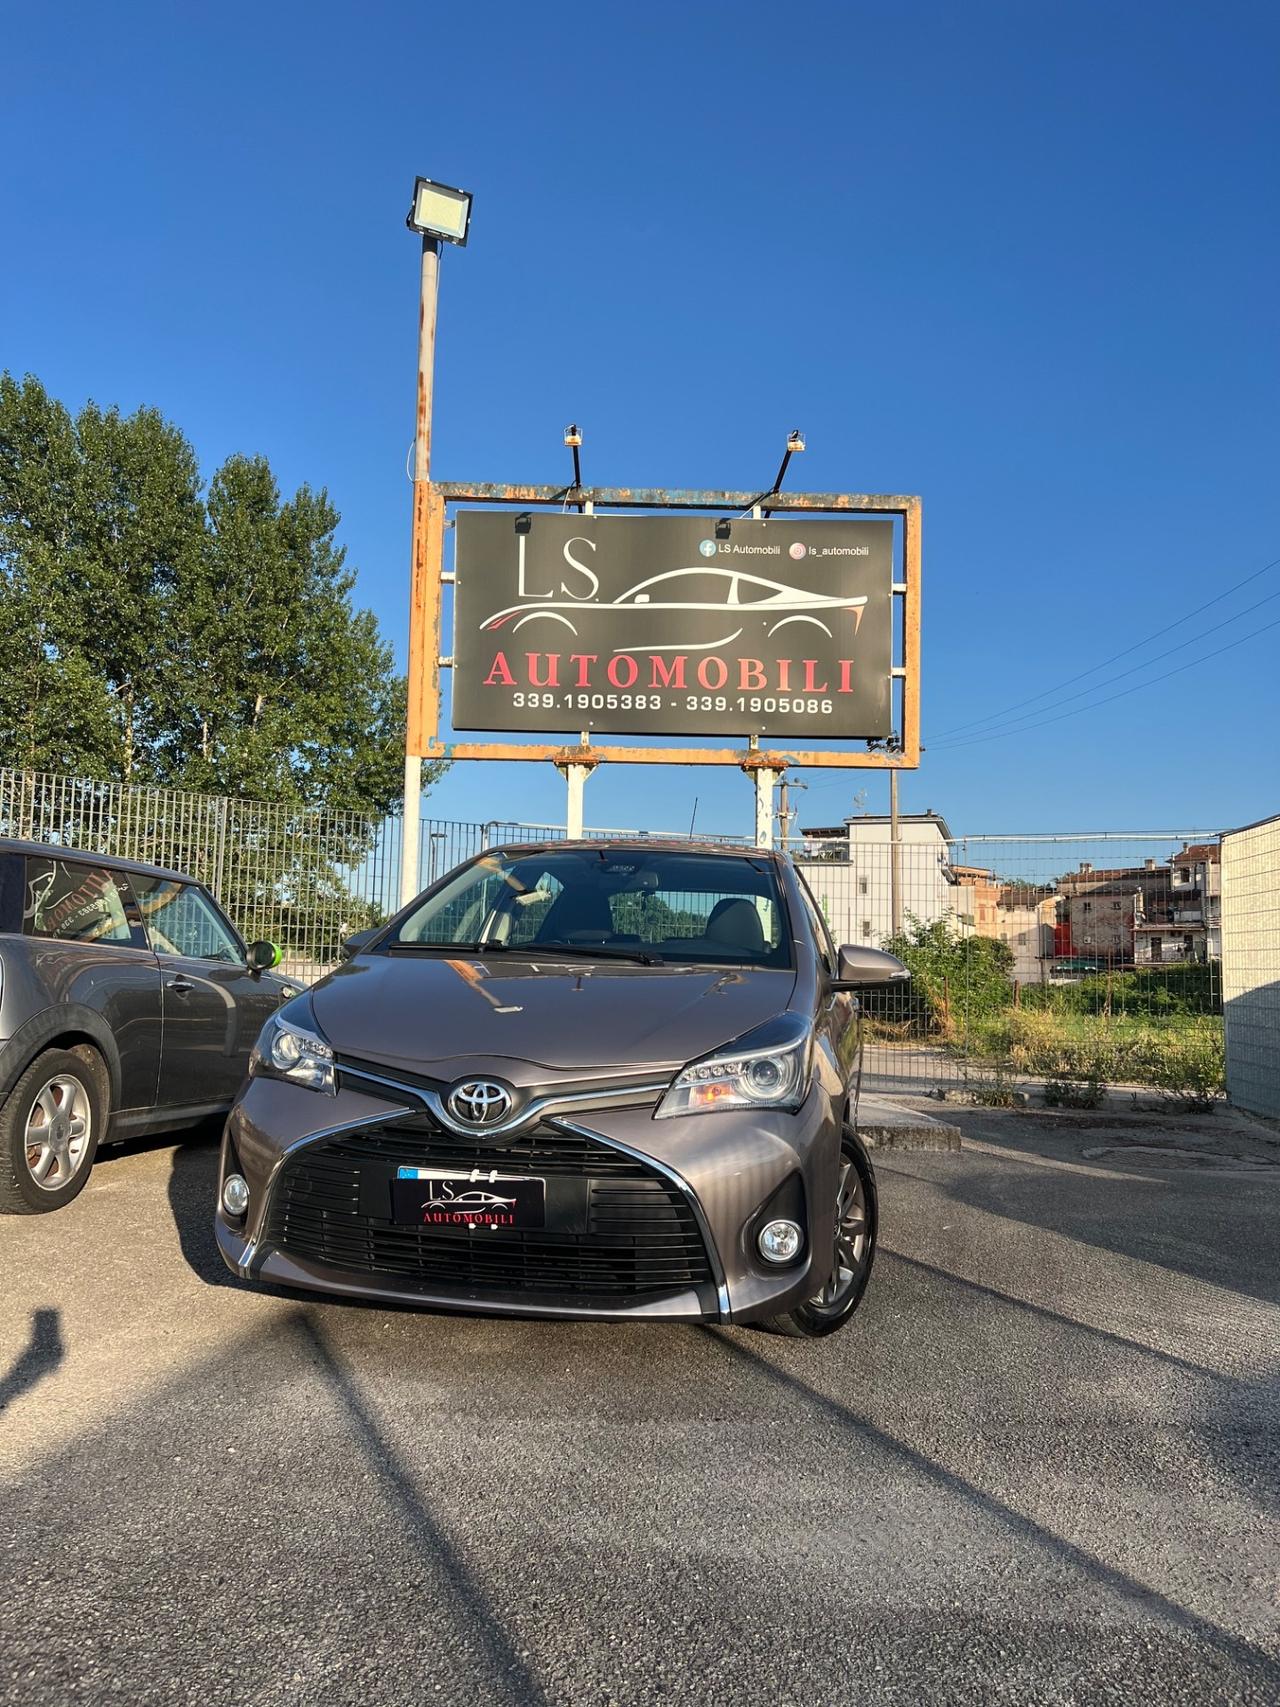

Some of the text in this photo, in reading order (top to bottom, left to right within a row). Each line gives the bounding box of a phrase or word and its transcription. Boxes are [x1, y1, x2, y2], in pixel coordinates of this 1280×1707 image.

[718, 544, 781, 555] LS Automobili
[808, 546, 869, 557] ls_automobili
[518, 535, 599, 600] LS
[482, 651, 855, 693] AUTOMOBILI
[512, 692, 662, 710] 339.1905383
[686, 696, 833, 714] 339.1905086
[429, 1180, 455, 1201] LS
[423, 1212, 513, 1224] AUTOMOBILI
